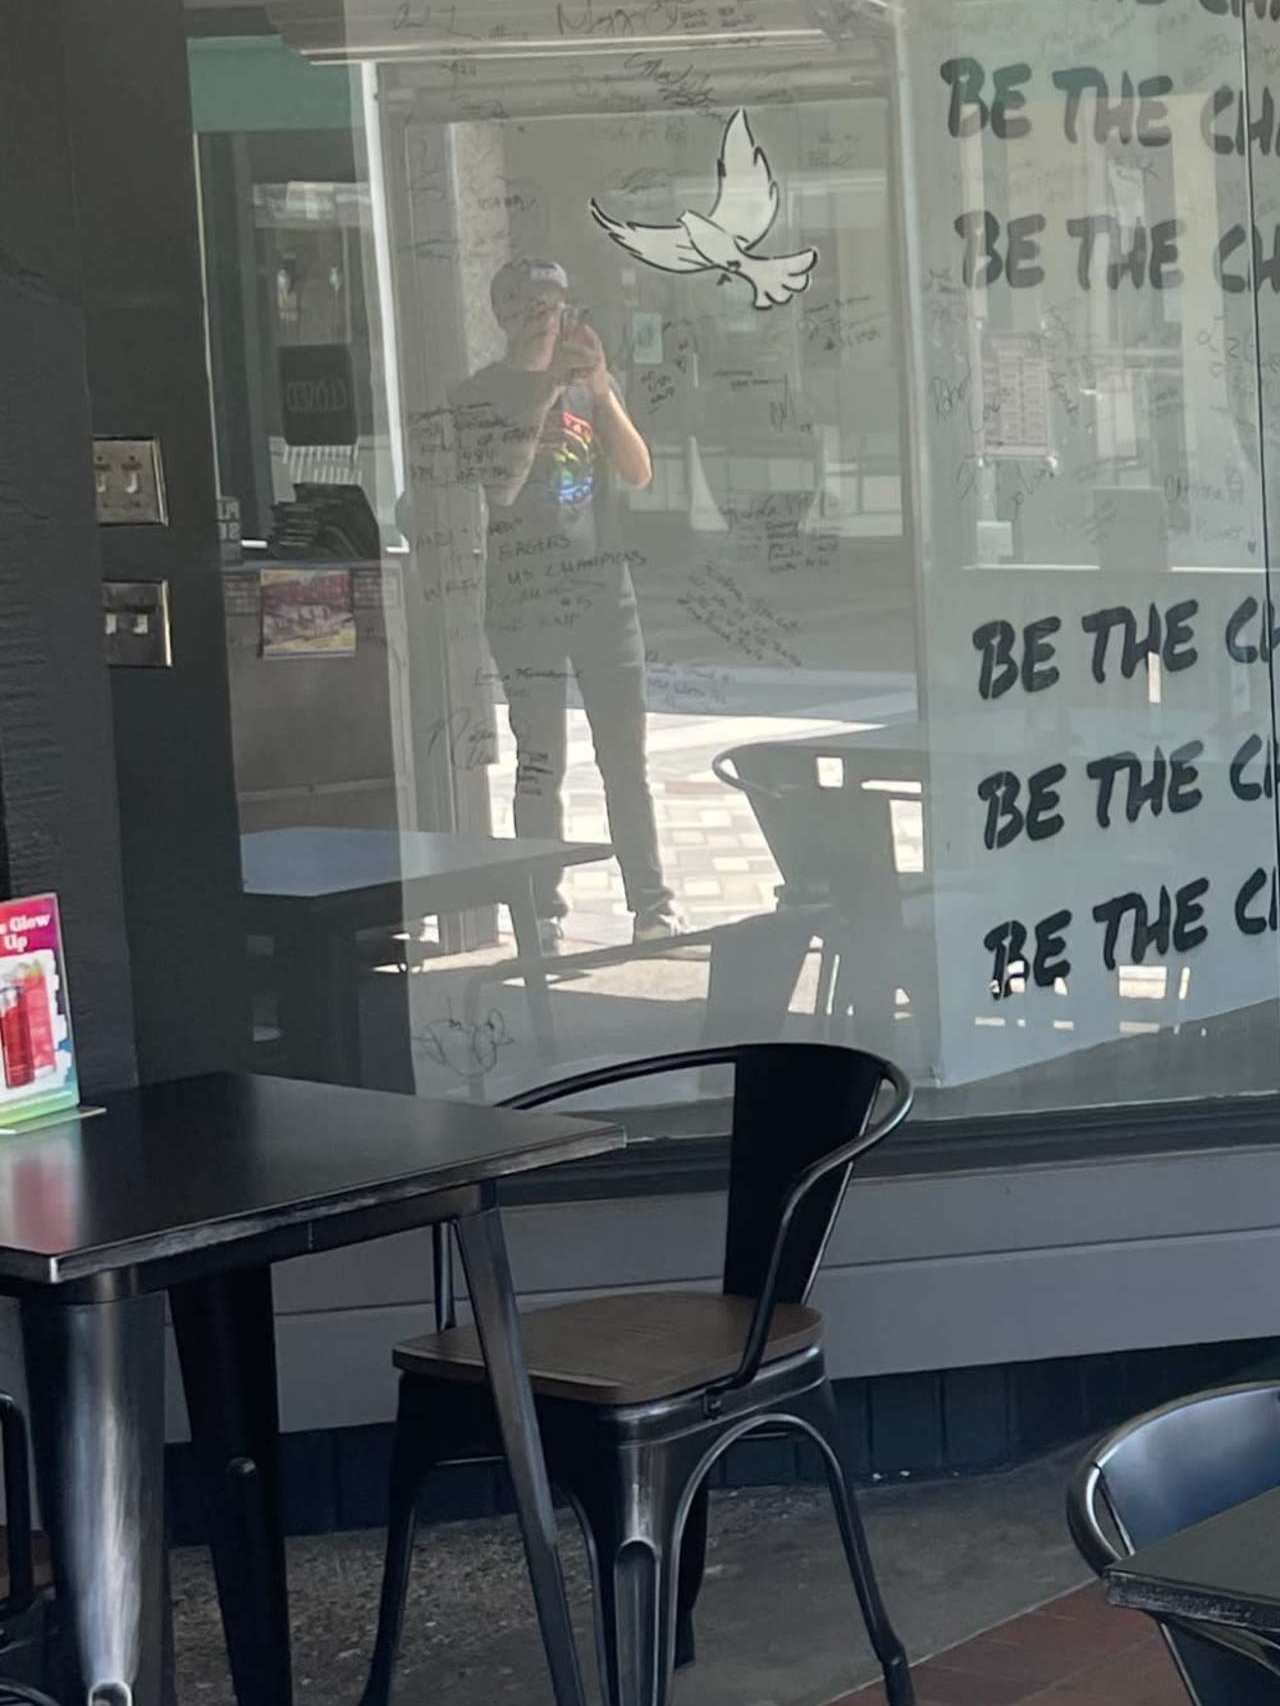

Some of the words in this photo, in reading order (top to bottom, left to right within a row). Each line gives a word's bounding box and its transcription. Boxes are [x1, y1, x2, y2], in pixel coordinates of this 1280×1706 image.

[940, 57, 1032, 139] BE
[1052, 66, 1173, 146] THE
[954, 210, 1045, 289] BE
[1066, 214, 1187, 291] THE
[972, 615, 1061, 699] BE
[1082, 599, 1198, 684] THE
[978, 763, 1067, 850] BE
[1086, 740, 1204, 828] THE
[4, 933, 28, 953] Up
[10, 914, 50, 932] Glow
[983, 908, 1072, 1000] BE
[1092, 877, 1209, 971] THE
